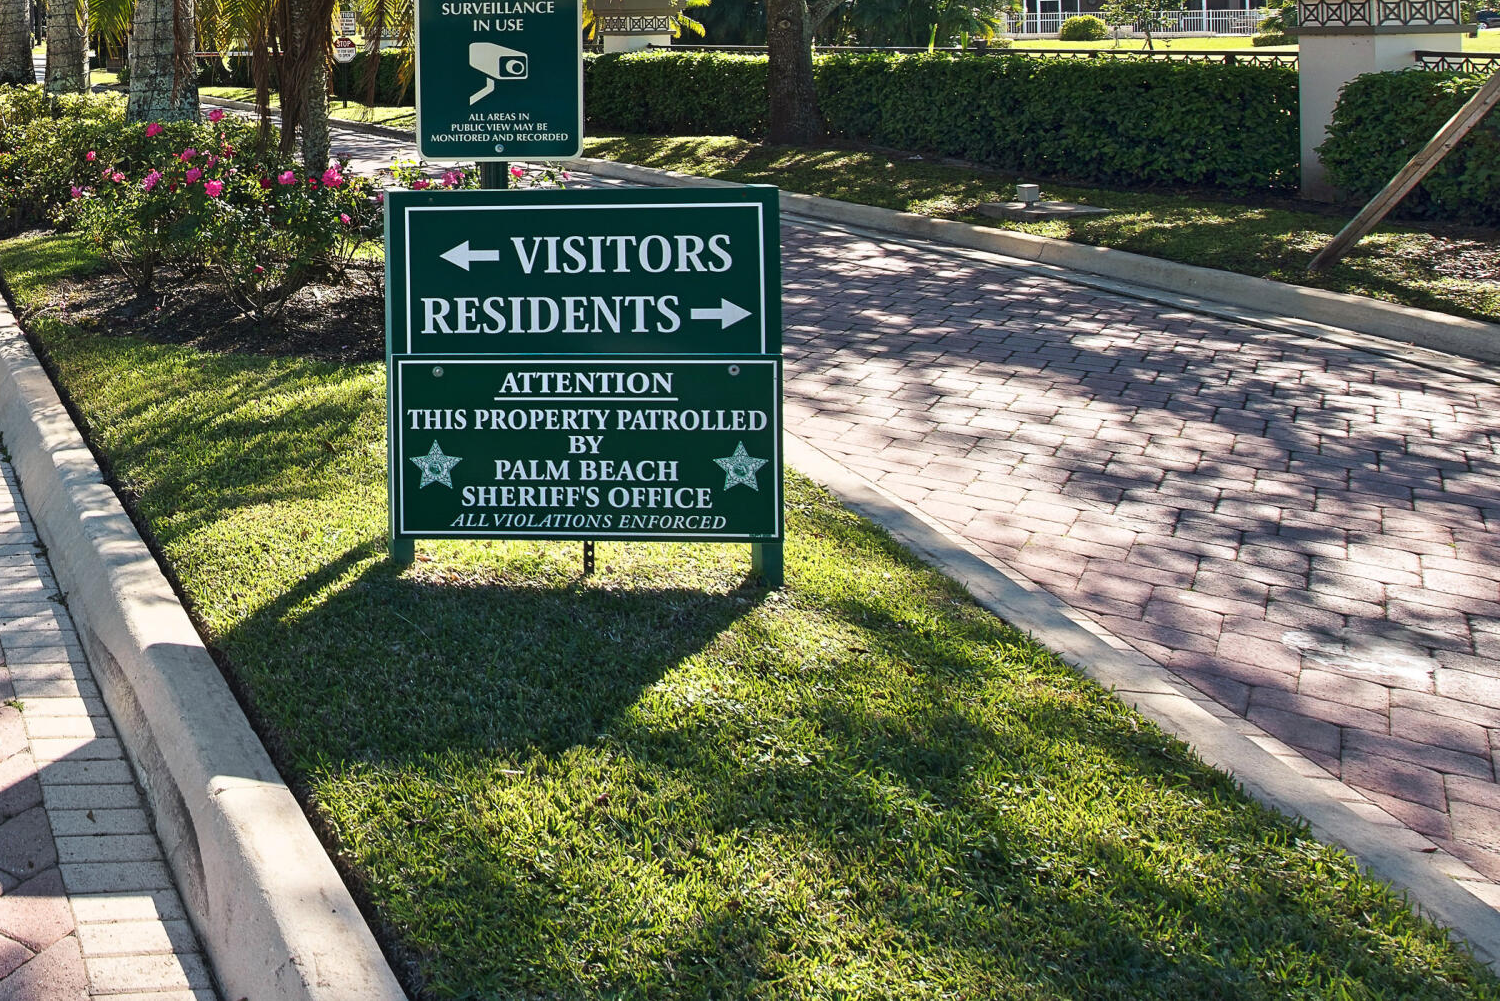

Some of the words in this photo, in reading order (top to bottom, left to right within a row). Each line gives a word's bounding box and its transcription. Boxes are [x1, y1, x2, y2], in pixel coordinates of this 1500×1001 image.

[441, 1, 555, 16] SURVEILLANCE
[473, 19, 490, 32] IN
[496, 18, 524, 32] USE
[336, 40, 351, 48] STOP
[468, 113, 485, 121] ALL
[487, 113, 516, 121] AREAS
[518, 112, 530, 121] IN
[451, 123, 485, 132] PUBLIC
[486, 123, 511, 132] VIEW
[513, 123, 534, 131] MAY
[536, 122, 548, 131] BE
[430, 133, 490, 142] MONITORED
[492, 133, 514, 142] AND
[516, 132, 569, 142] RECORDED
[510, 235, 733, 274] VISITORS
[420, 295, 681, 334] RESIDENTS
[499, 371, 674, 394] ATTENTION
[407, 408, 467, 430] THIS
[473, 408, 611, 431] PROPERTY
[616, 409, 768, 431] PATROLLED
[567, 435, 604, 454] BY
[494, 459, 571, 481] PALM
[579, 460, 679, 482] BEACH
[461, 485, 600, 508] SHERIFF'S
[607, 486, 713, 509] OFFICE
[450, 513, 492, 527] ALL
[493, 513, 612, 528] VIOLATIONS
[618, 514, 727, 529] ENFORCED
